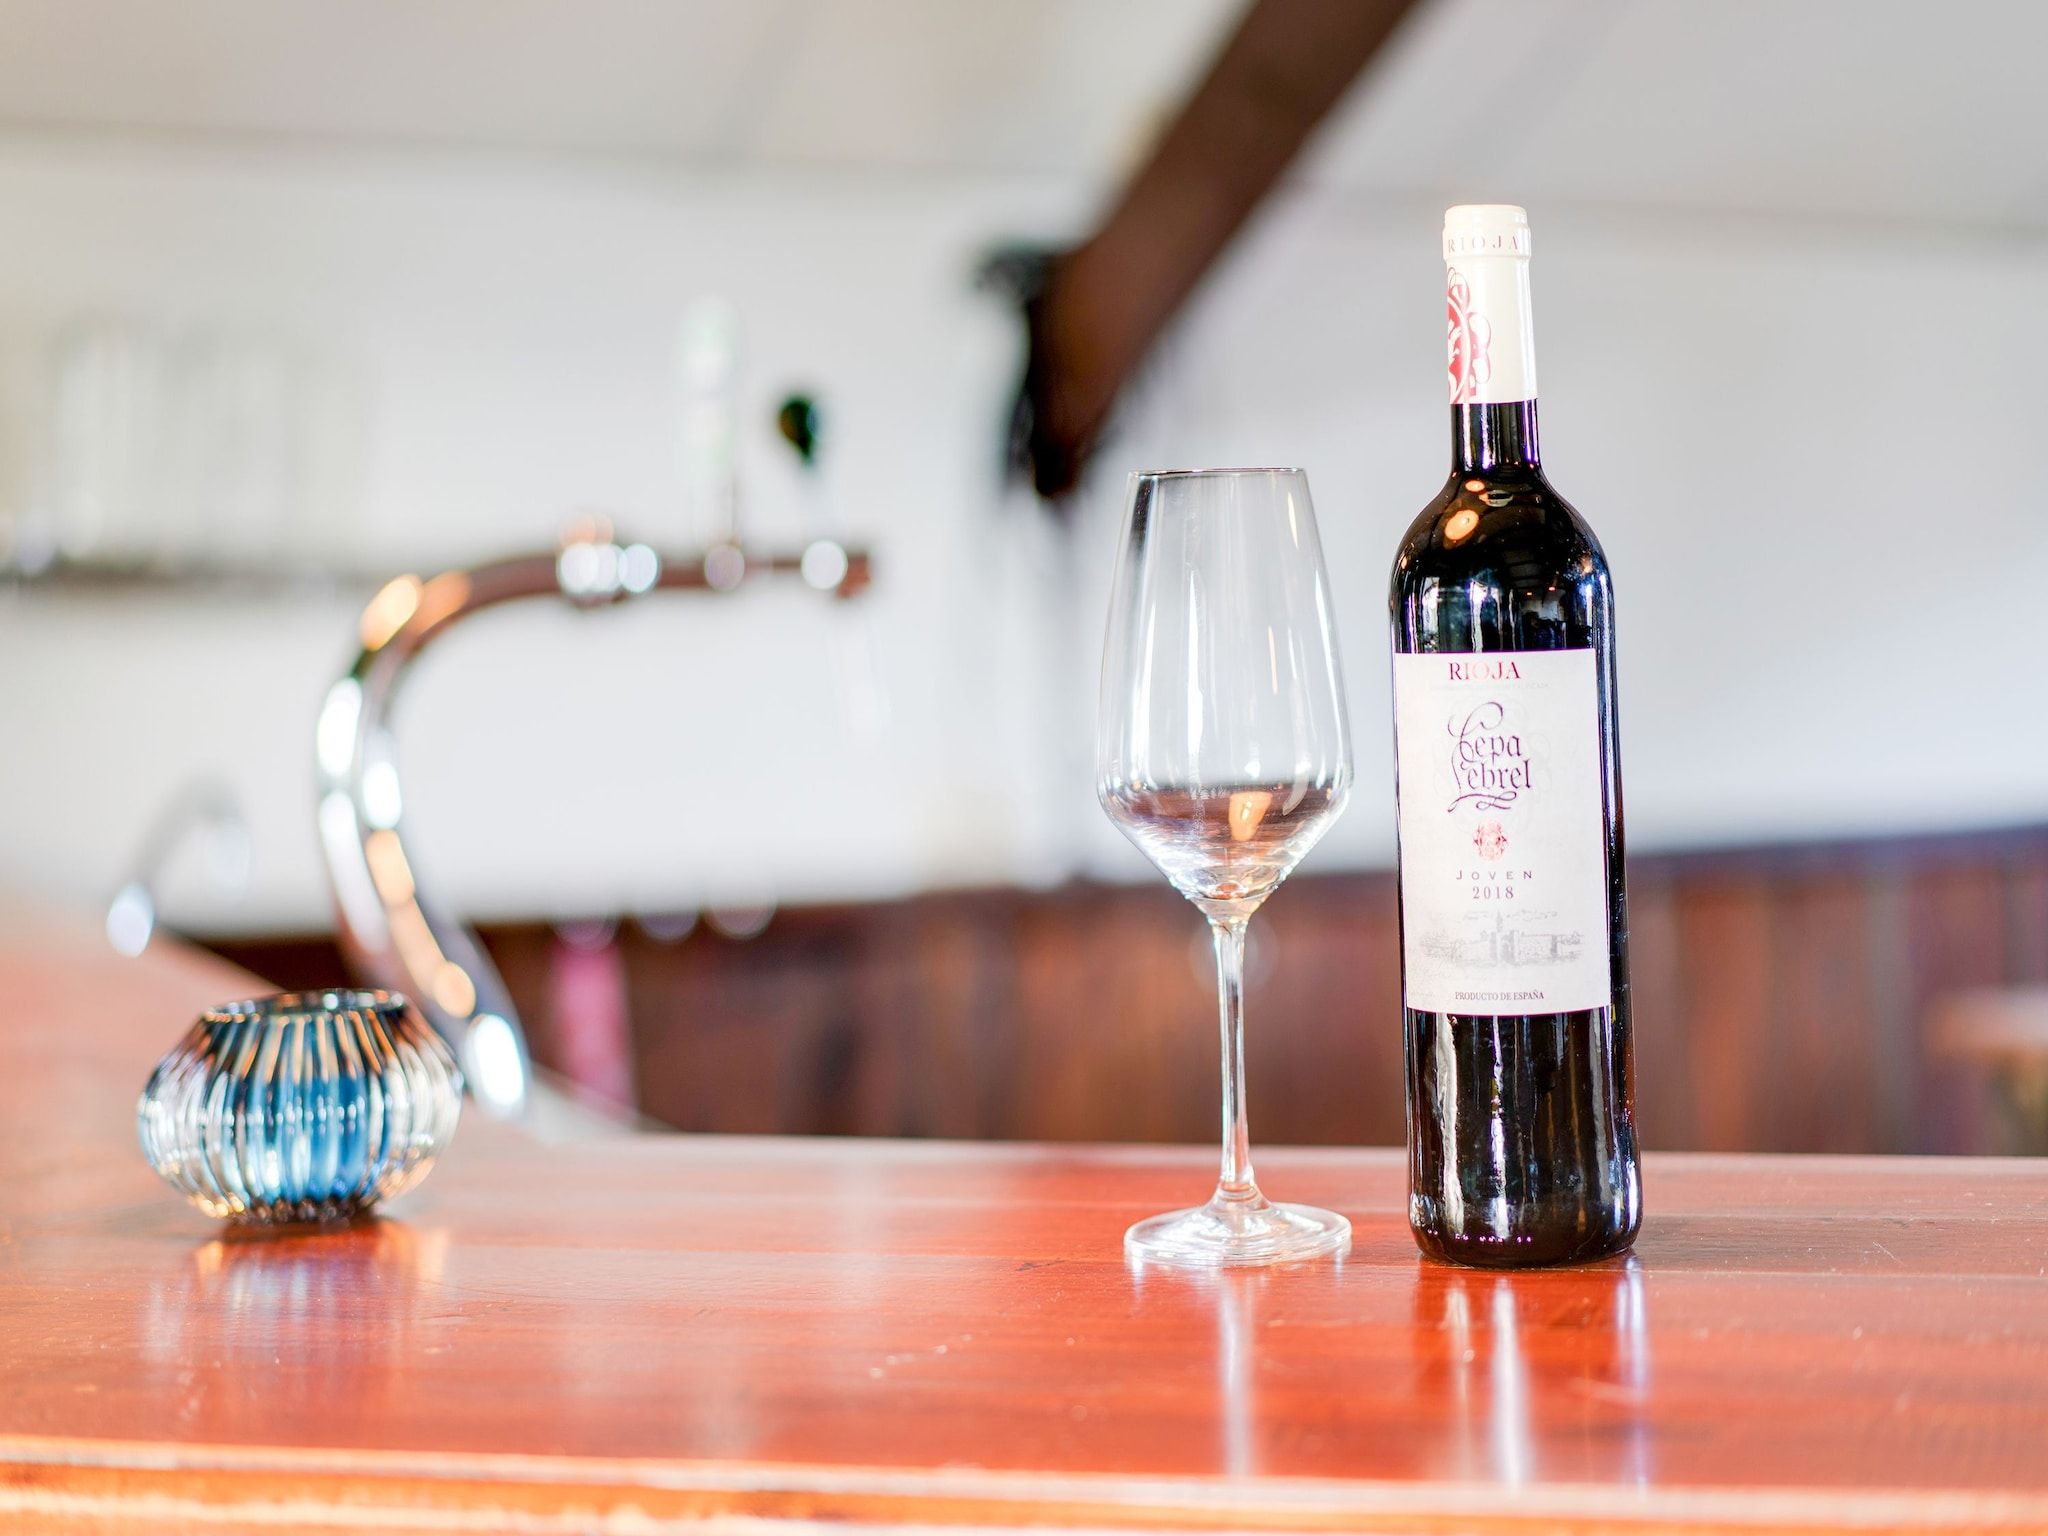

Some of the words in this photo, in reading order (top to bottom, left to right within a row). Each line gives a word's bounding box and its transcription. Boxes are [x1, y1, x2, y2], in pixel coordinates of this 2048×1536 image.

[1447, 234, 1520, 254] RIOJA
[1448, 661, 1521, 681] RIOJA
[1447, 701, 1522, 766] Cepa
[1455, 869, 1533, 881] JOVEN
[1472, 886, 1515, 900] 2018
[1455, 990, 1499, 1001] PRODUCTO
[1500, 991, 1512, 1001] DE
[1513, 988, 1545, 1001] ESPAÑA
